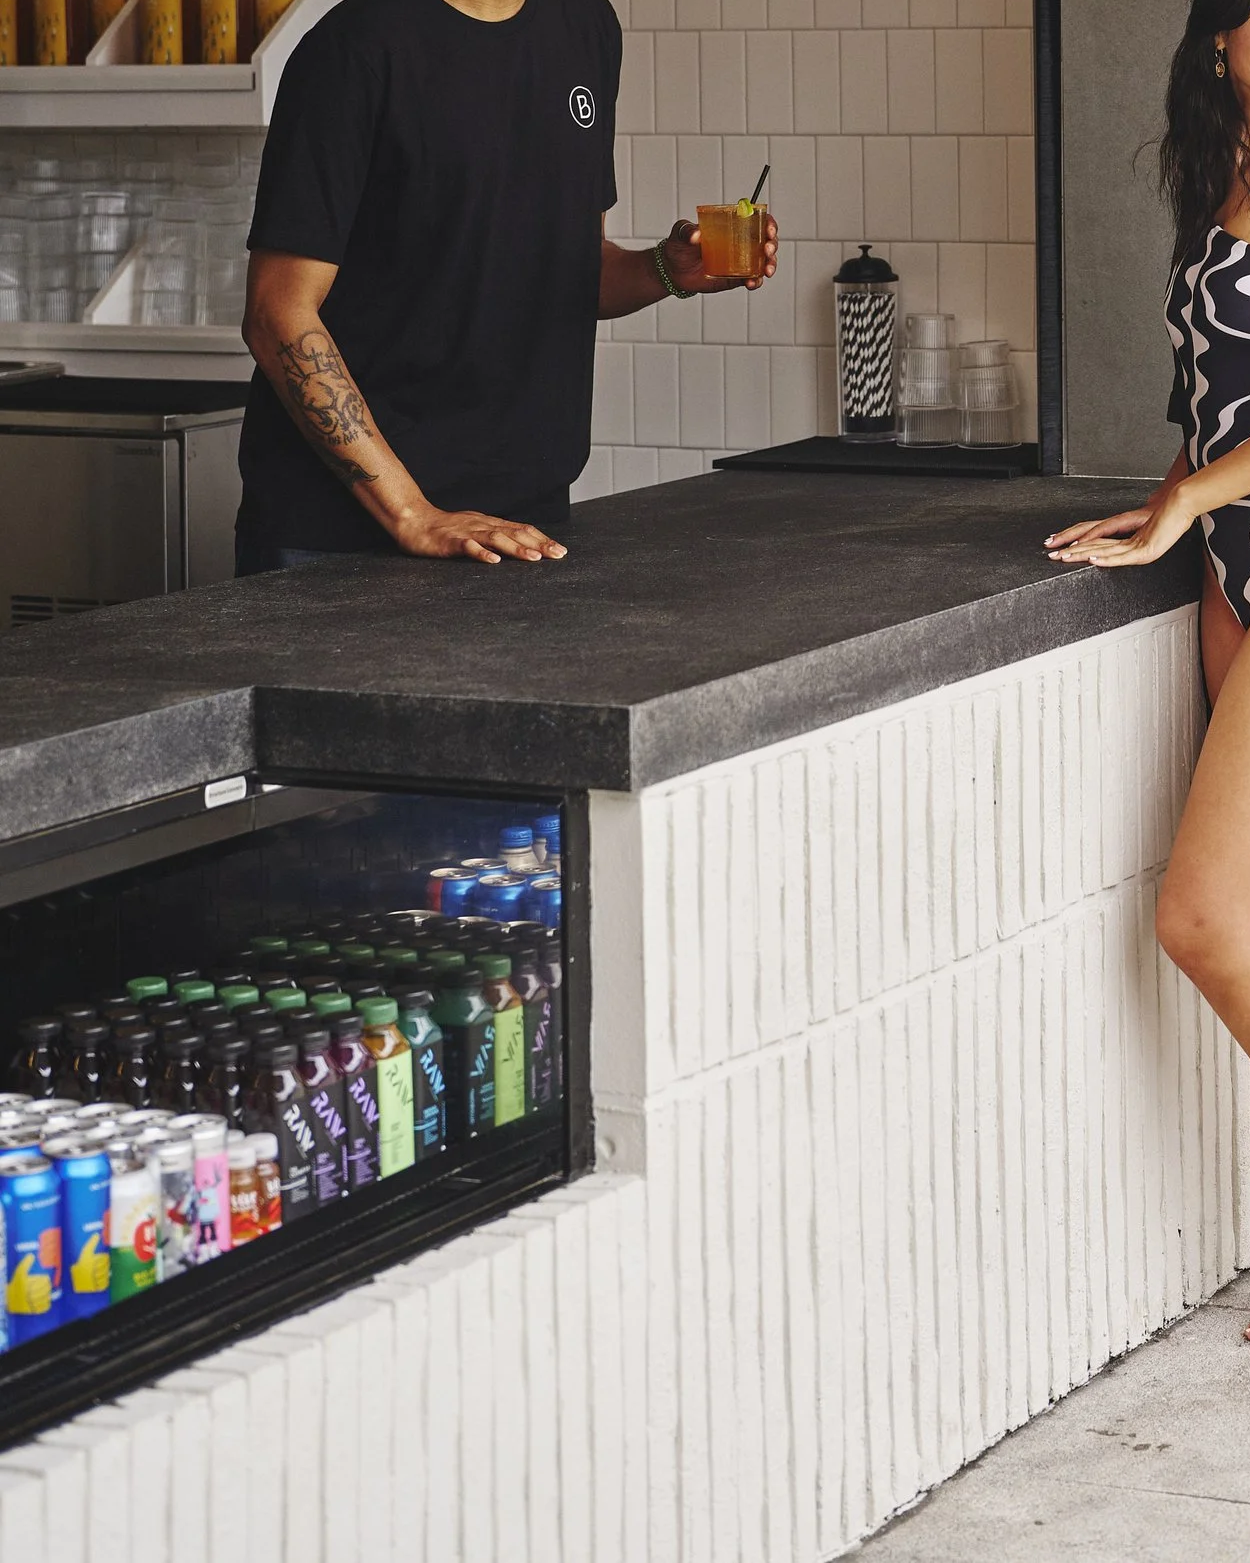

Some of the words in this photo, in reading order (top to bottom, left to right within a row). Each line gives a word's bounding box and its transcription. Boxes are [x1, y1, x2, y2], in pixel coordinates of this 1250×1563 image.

[576, 94, 592, 119] B
[386, 1063, 414, 1106] RAW
[420, 1048, 446, 1096] RAW
[310, 1090, 347, 1140] RAW
[349, 1076, 380, 1126] RAW
[283, 1103, 316, 1154] RAW
